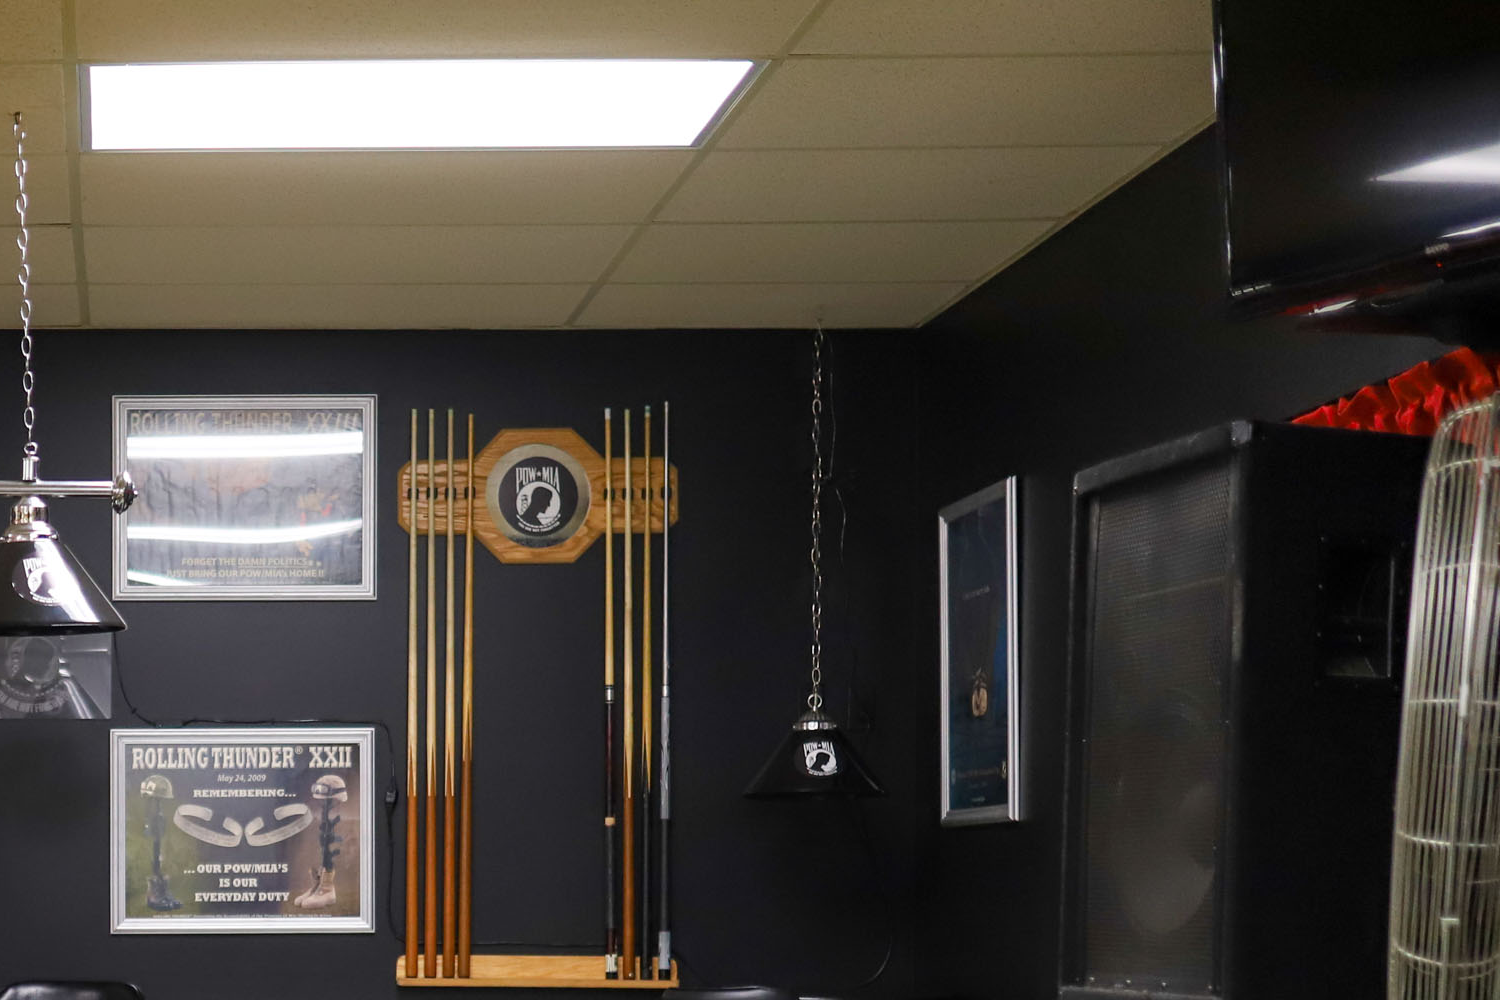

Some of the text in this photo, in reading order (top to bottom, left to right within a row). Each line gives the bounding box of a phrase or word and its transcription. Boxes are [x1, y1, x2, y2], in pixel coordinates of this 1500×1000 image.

[131, 412, 205, 434] ROLLING
[132, 747, 208, 769] ROLLING
[308, 746, 352, 768] XXII
[217, 774, 234, 784] May
[247, 774, 266, 783] 2009
[219, 878, 258, 888] IS OUR
[195, 892, 290, 902] EVERYDAY DUTY
